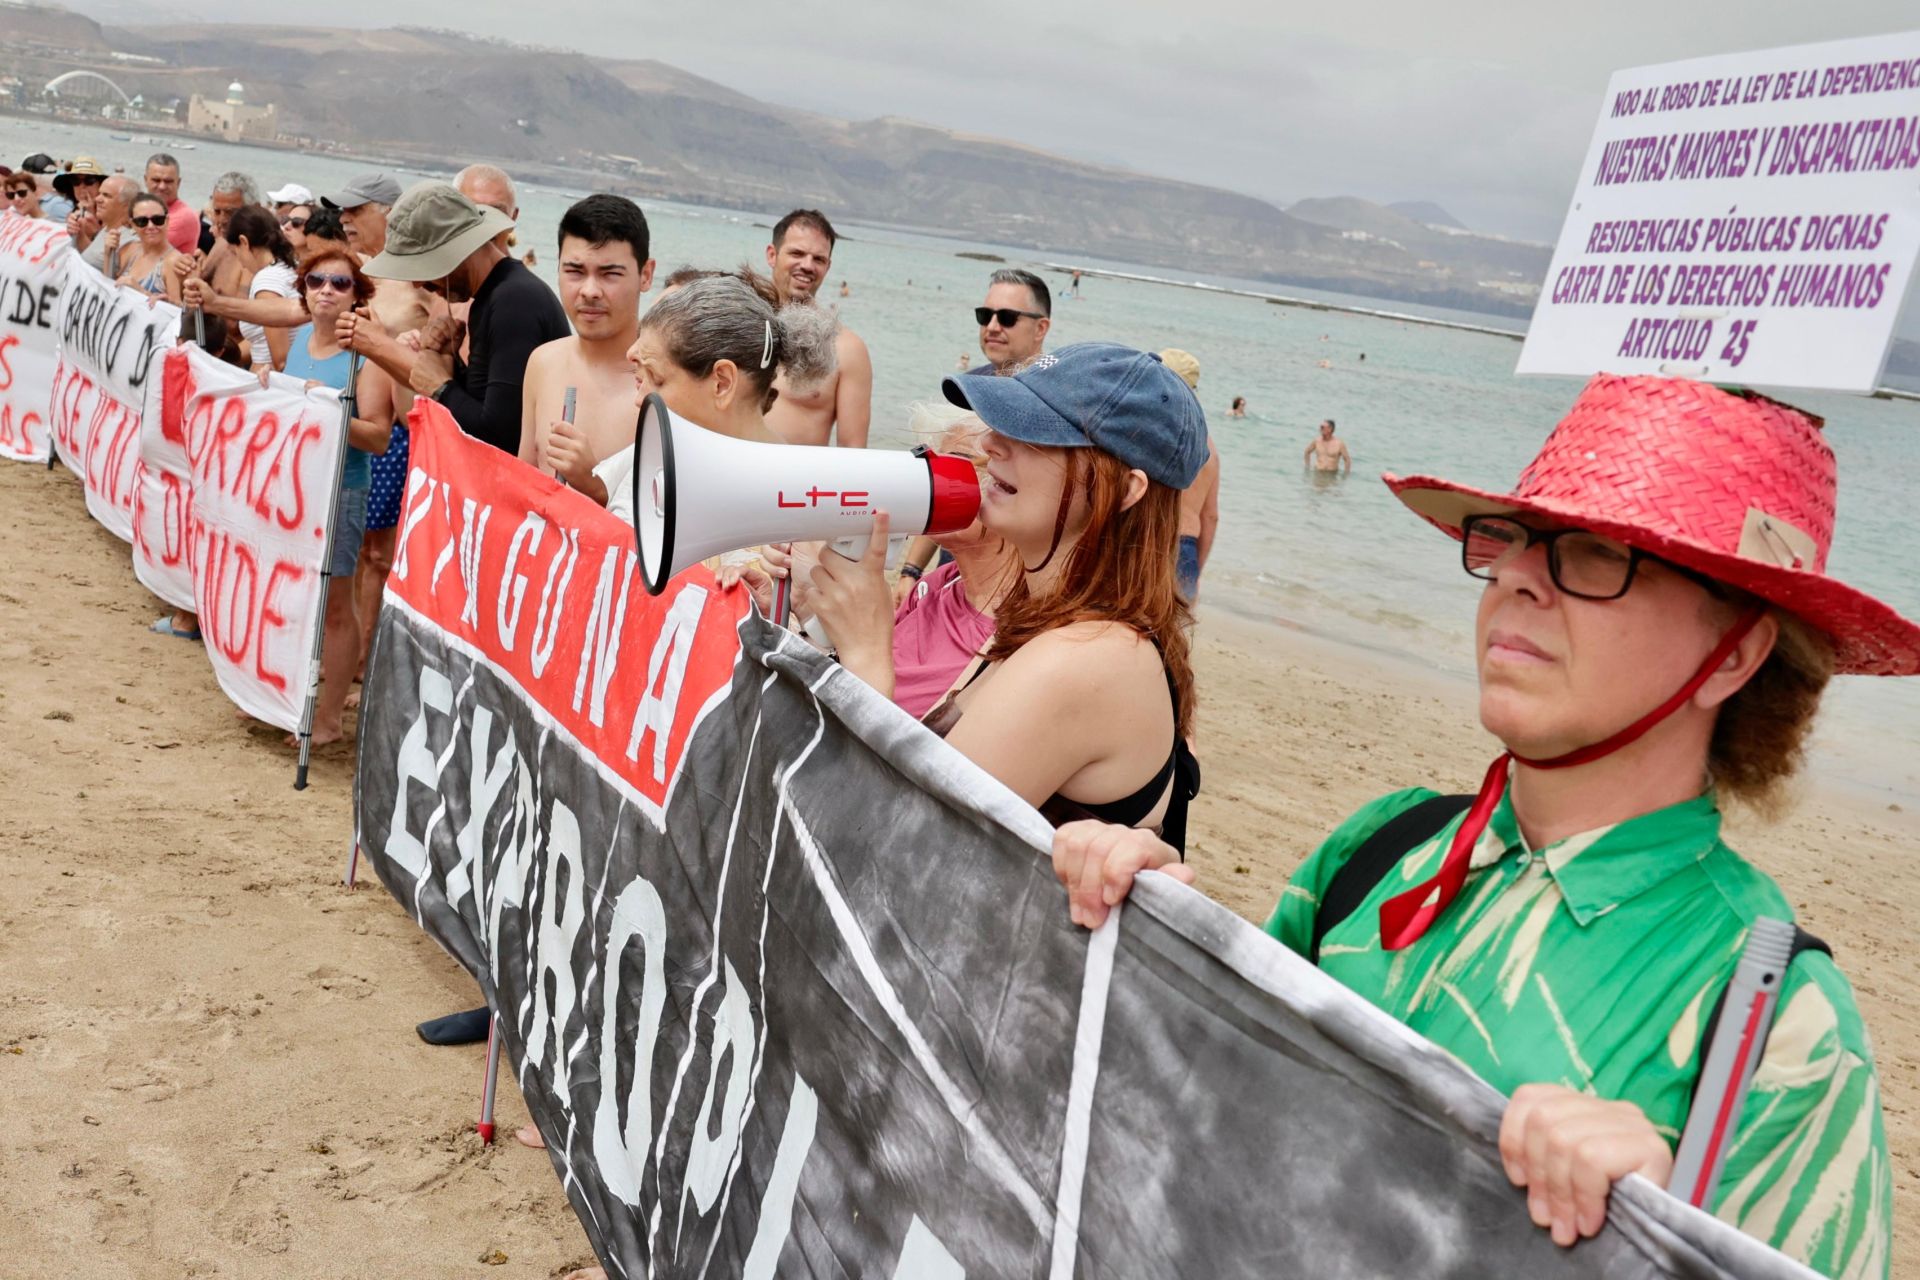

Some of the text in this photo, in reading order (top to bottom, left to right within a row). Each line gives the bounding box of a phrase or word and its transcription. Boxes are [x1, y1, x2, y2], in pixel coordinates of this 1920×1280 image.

[1639, 86, 1659, 114] AL
[1658, 81, 1699, 112] ROBO
[1698, 79, 1723, 107] DE
[1721, 77, 1742, 105] LA
[1742, 73, 1774, 104] LEY
[1772, 71, 1798, 101] DE
[1795, 69, 1818, 98] LA
[1593, 133, 1678, 186] NUESTRAS
[1669, 127, 1758, 180] MAYORES
[1753, 126, 1776, 177] Y
[1585, 204, 1890, 254] RESIDENCIAS PÚBLICAS DIGNAS
[1552, 262, 1892, 309] CARTA DE LOS DERECHOS HUMANOS
[1617, 317, 1759, 368] ARTICULO 25
